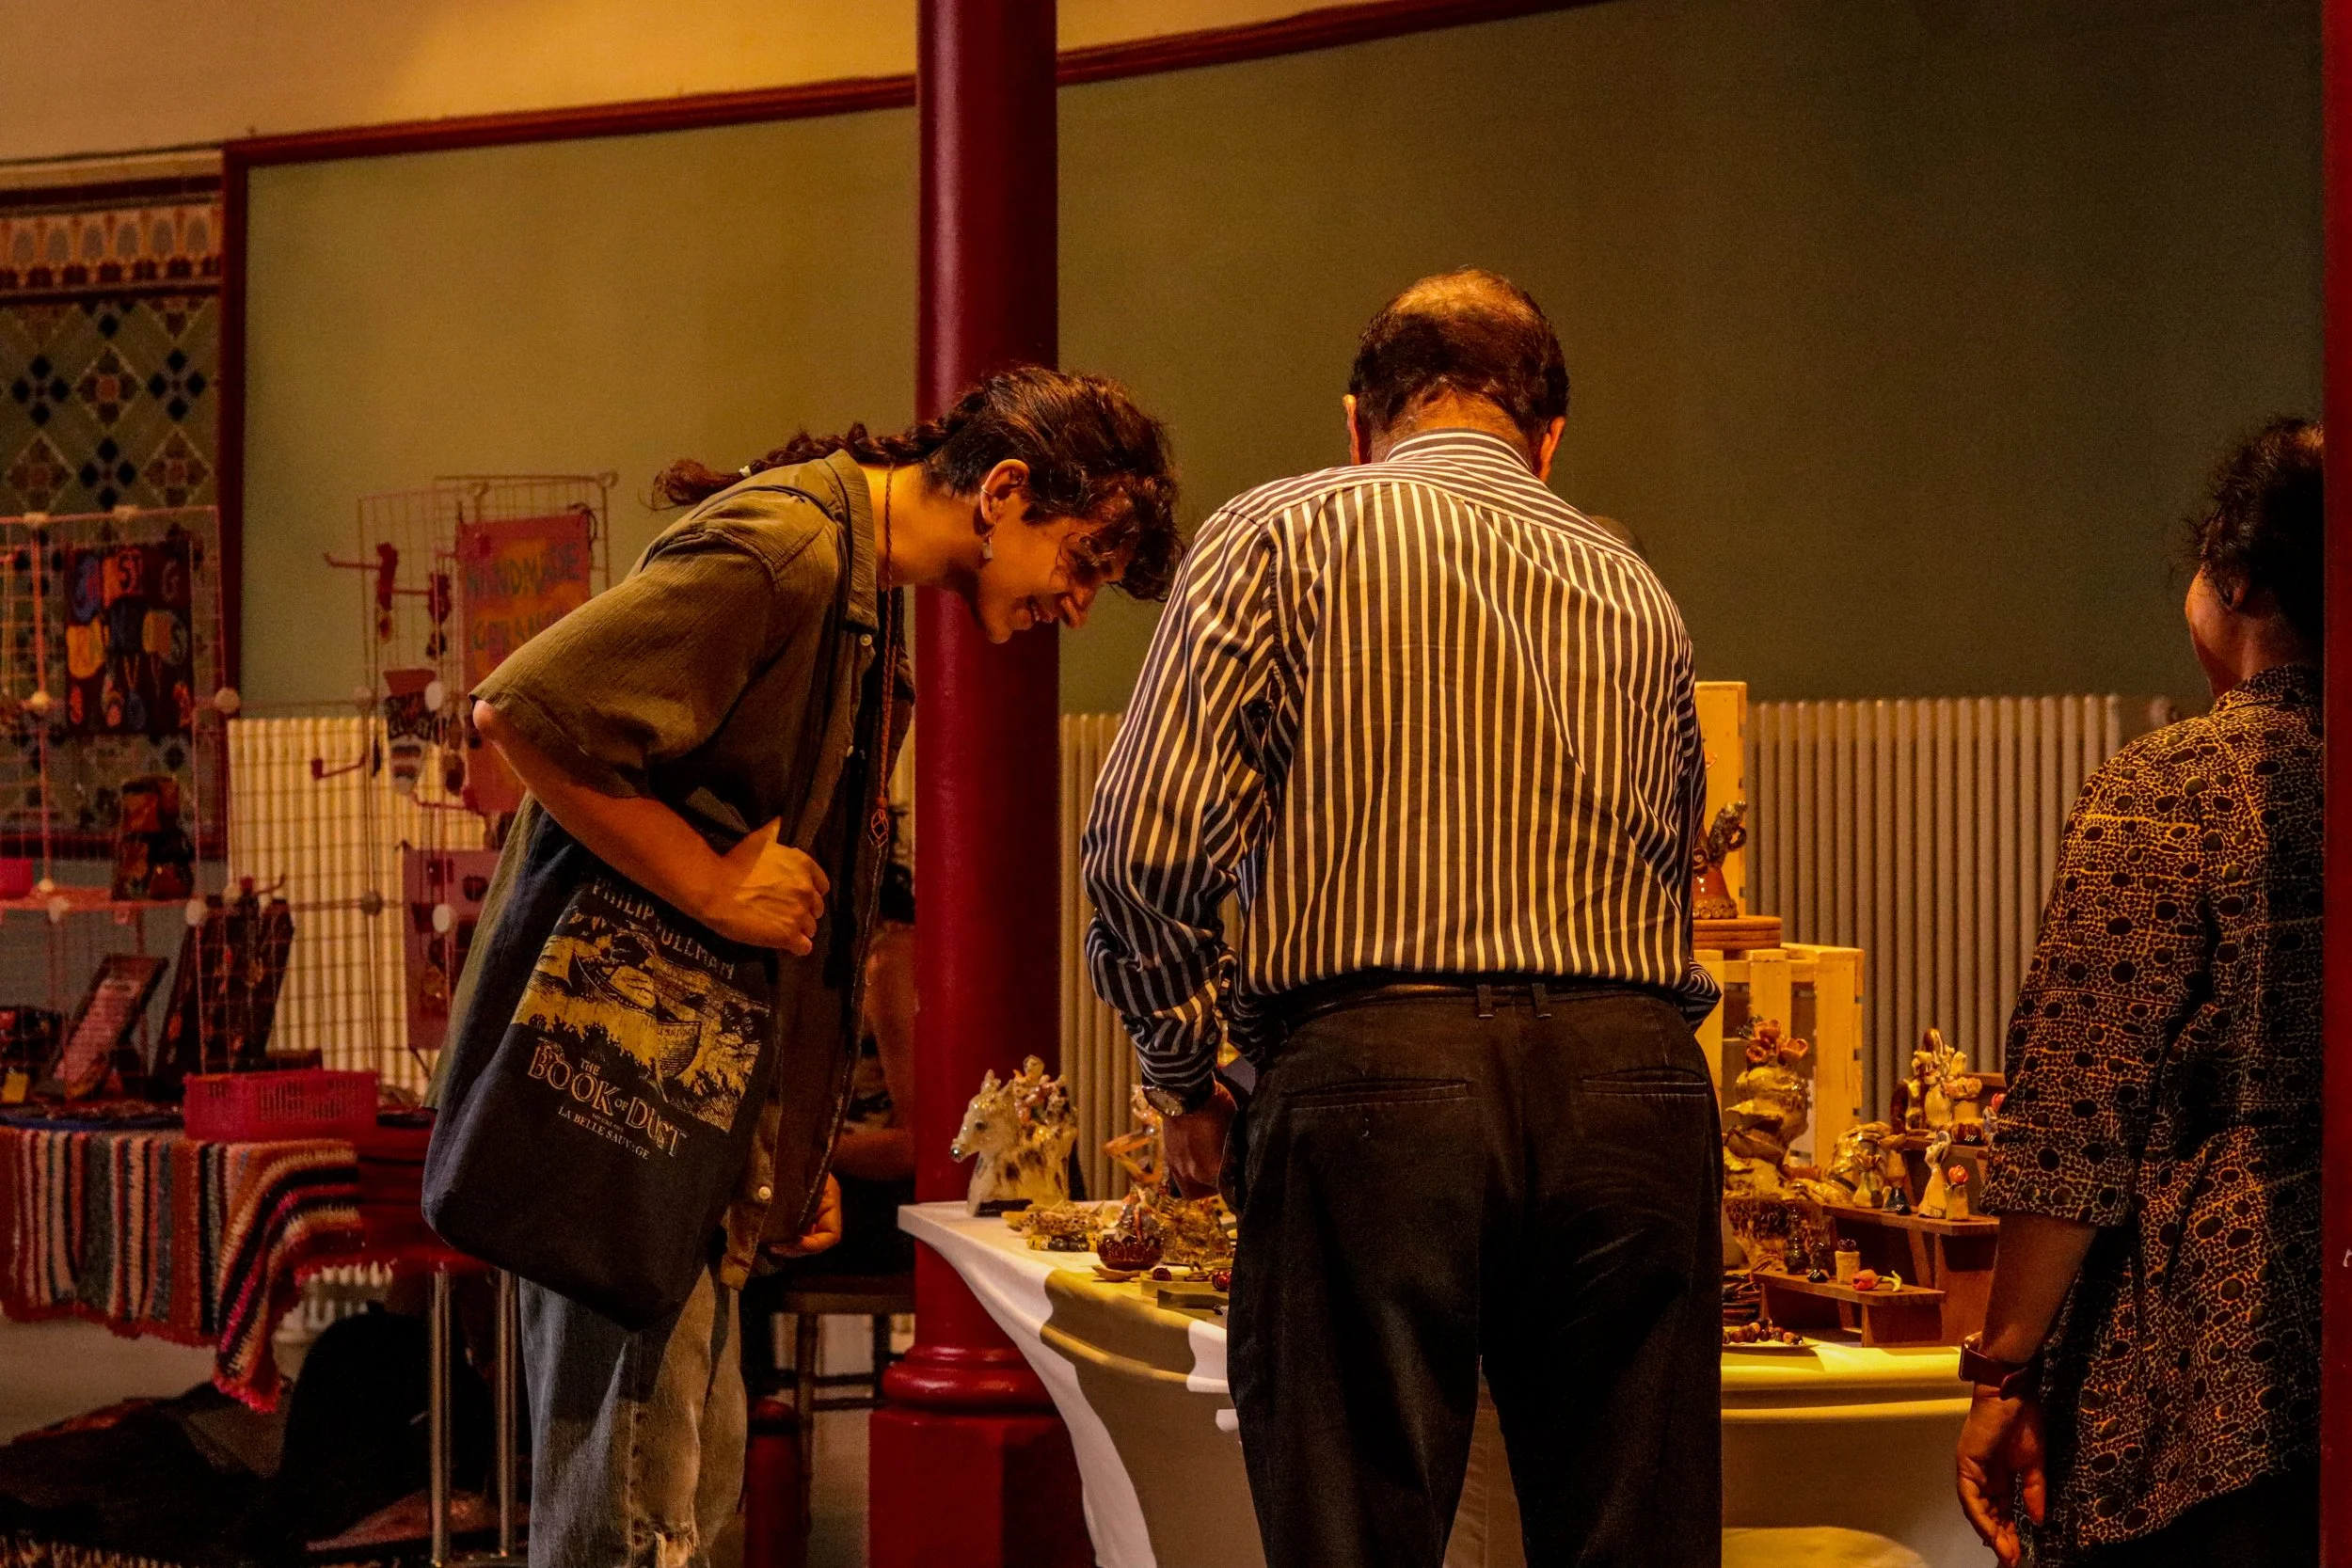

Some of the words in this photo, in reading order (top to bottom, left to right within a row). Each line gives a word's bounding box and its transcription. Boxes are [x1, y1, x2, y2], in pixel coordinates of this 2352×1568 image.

[580, 1056, 602, 1077] THE
[527, 1044, 622, 1117] BOOK
[613, 1097, 629, 1112] OF
[624, 1096, 689, 1158] DUST
[558, 1105, 572, 1120] LA
[572, 1112, 605, 1136] BELLE
